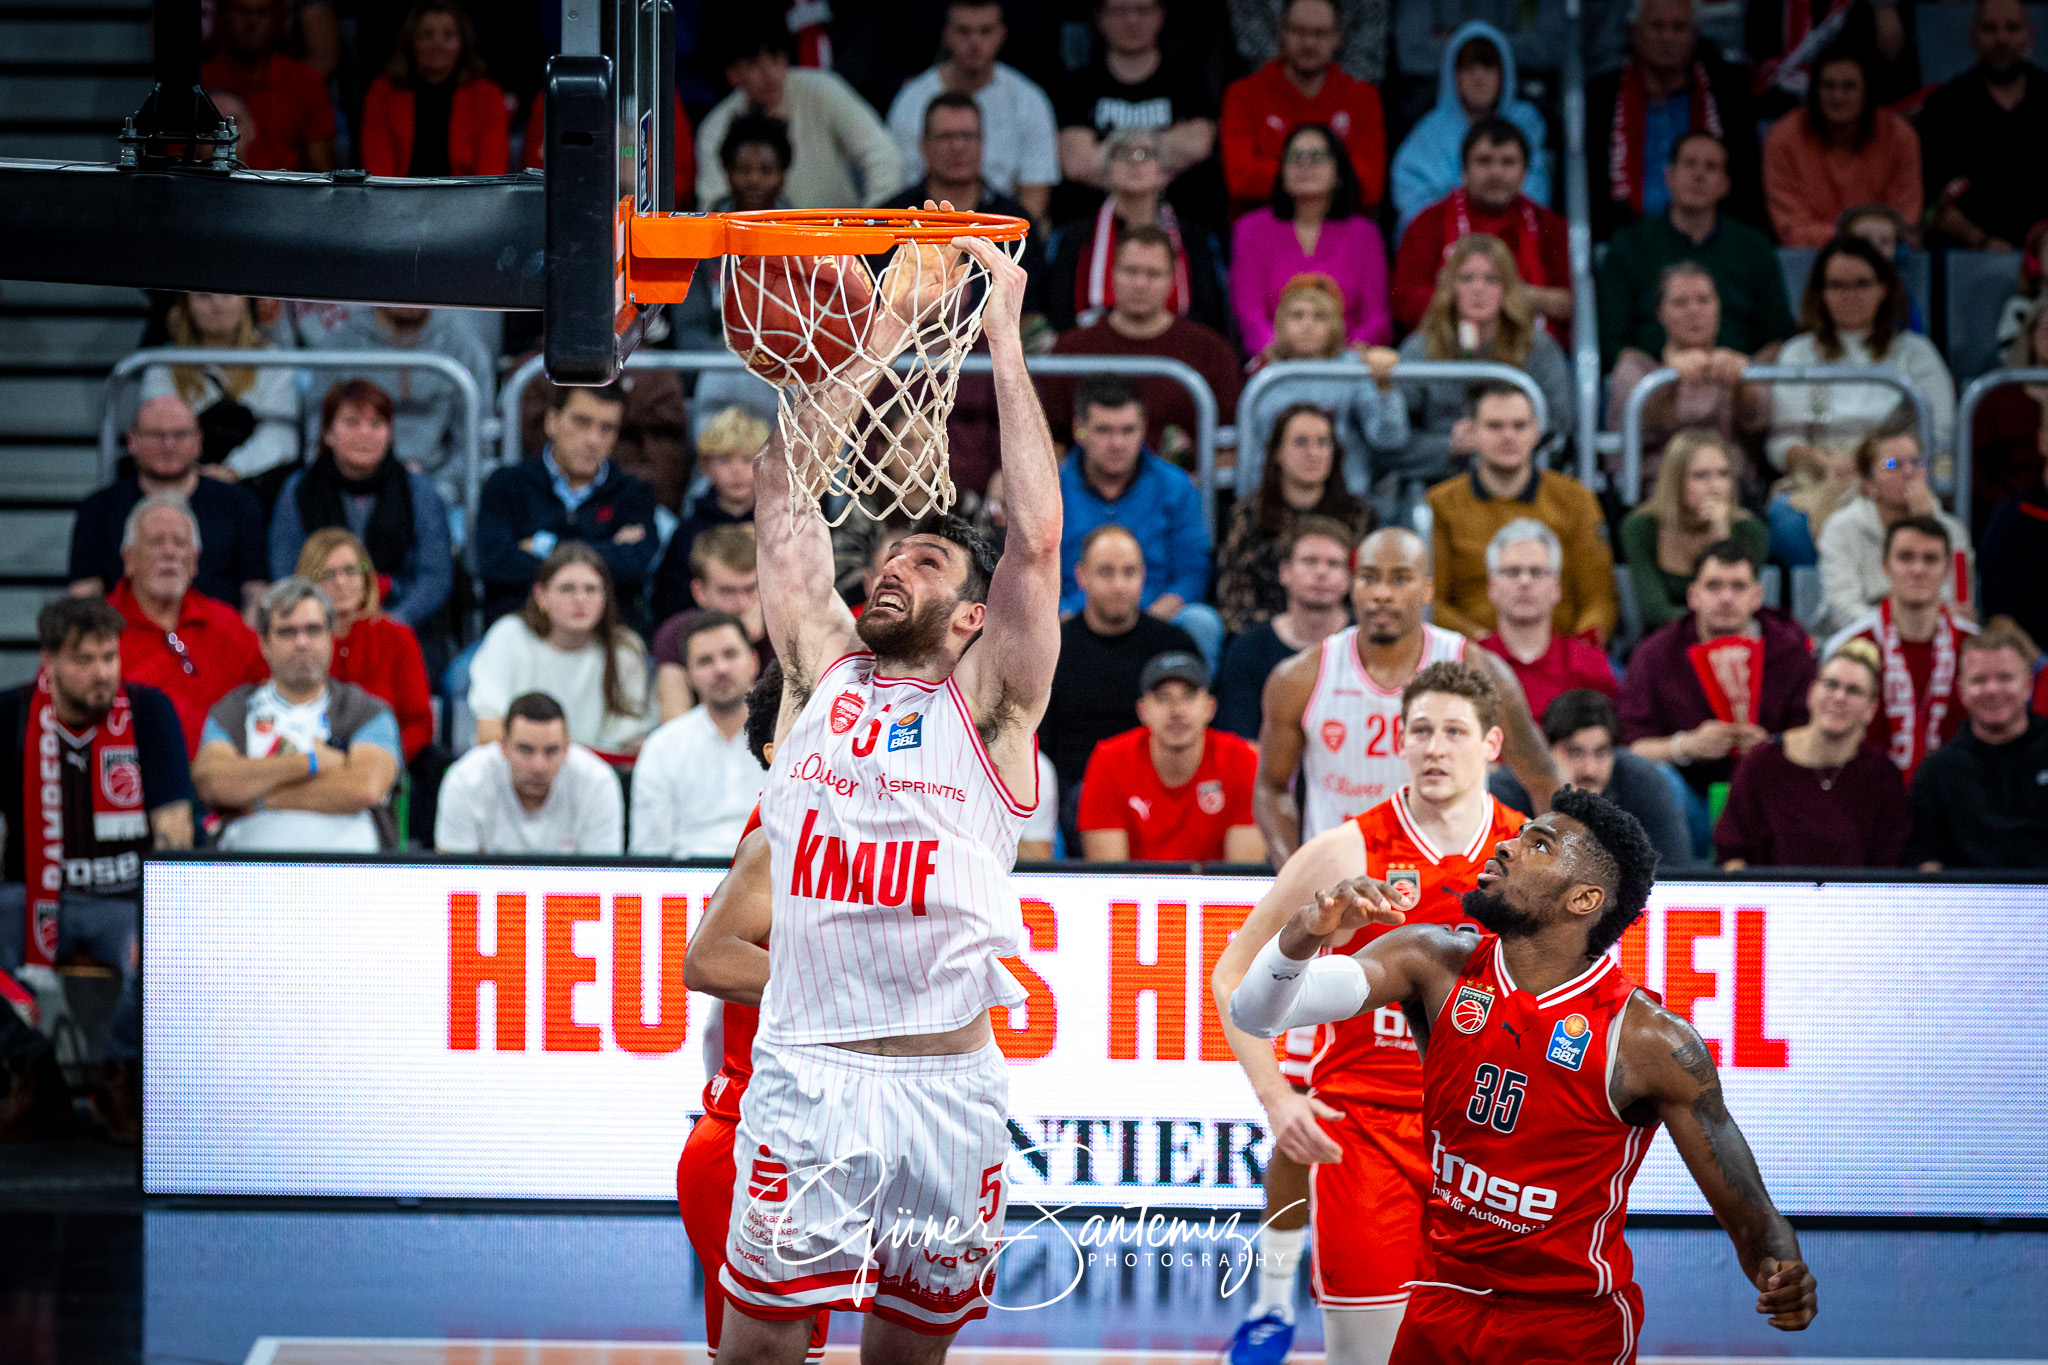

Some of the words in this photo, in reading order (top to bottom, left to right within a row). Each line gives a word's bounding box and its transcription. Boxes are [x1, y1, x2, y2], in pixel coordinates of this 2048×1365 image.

[889, 735, 918, 750] BBL
[888, 780, 967, 803] SPRINTIS
[790, 808, 940, 917] KNAUF
[1550, 1046, 1577, 1066] BBL
[1466, 1062, 1528, 1134] 35
[979, 1161, 1004, 1224] 5
